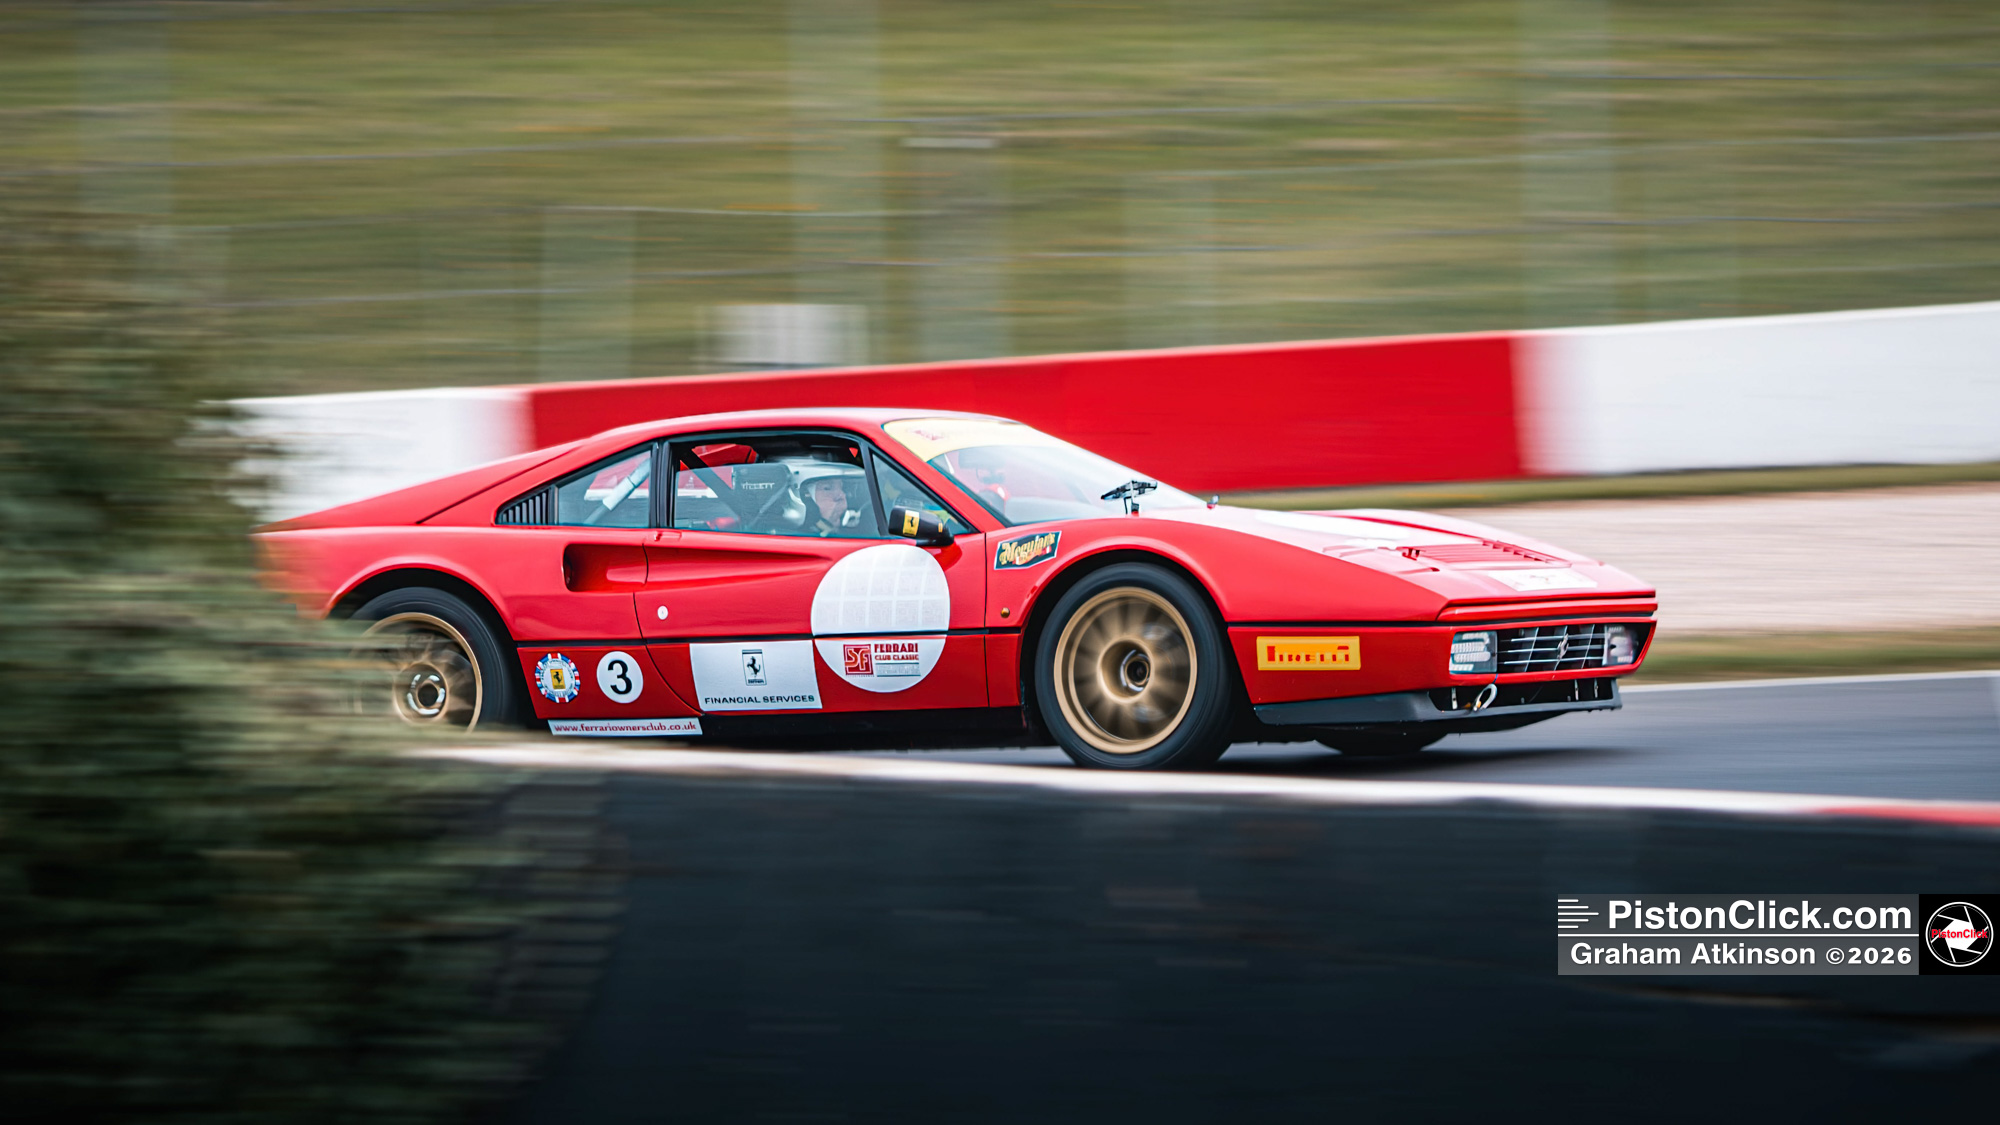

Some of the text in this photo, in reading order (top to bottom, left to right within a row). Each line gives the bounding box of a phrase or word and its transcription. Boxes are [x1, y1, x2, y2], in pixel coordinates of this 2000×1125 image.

[874, 643, 918, 653] FERRARI
[893, 653, 919, 661] CLASSIC
[607, 660, 633, 695] 3
[704, 694, 815, 705] FINANCIAL SERVICES
[554, 722, 697, 732] www.ferrariownersclub.co.uk
